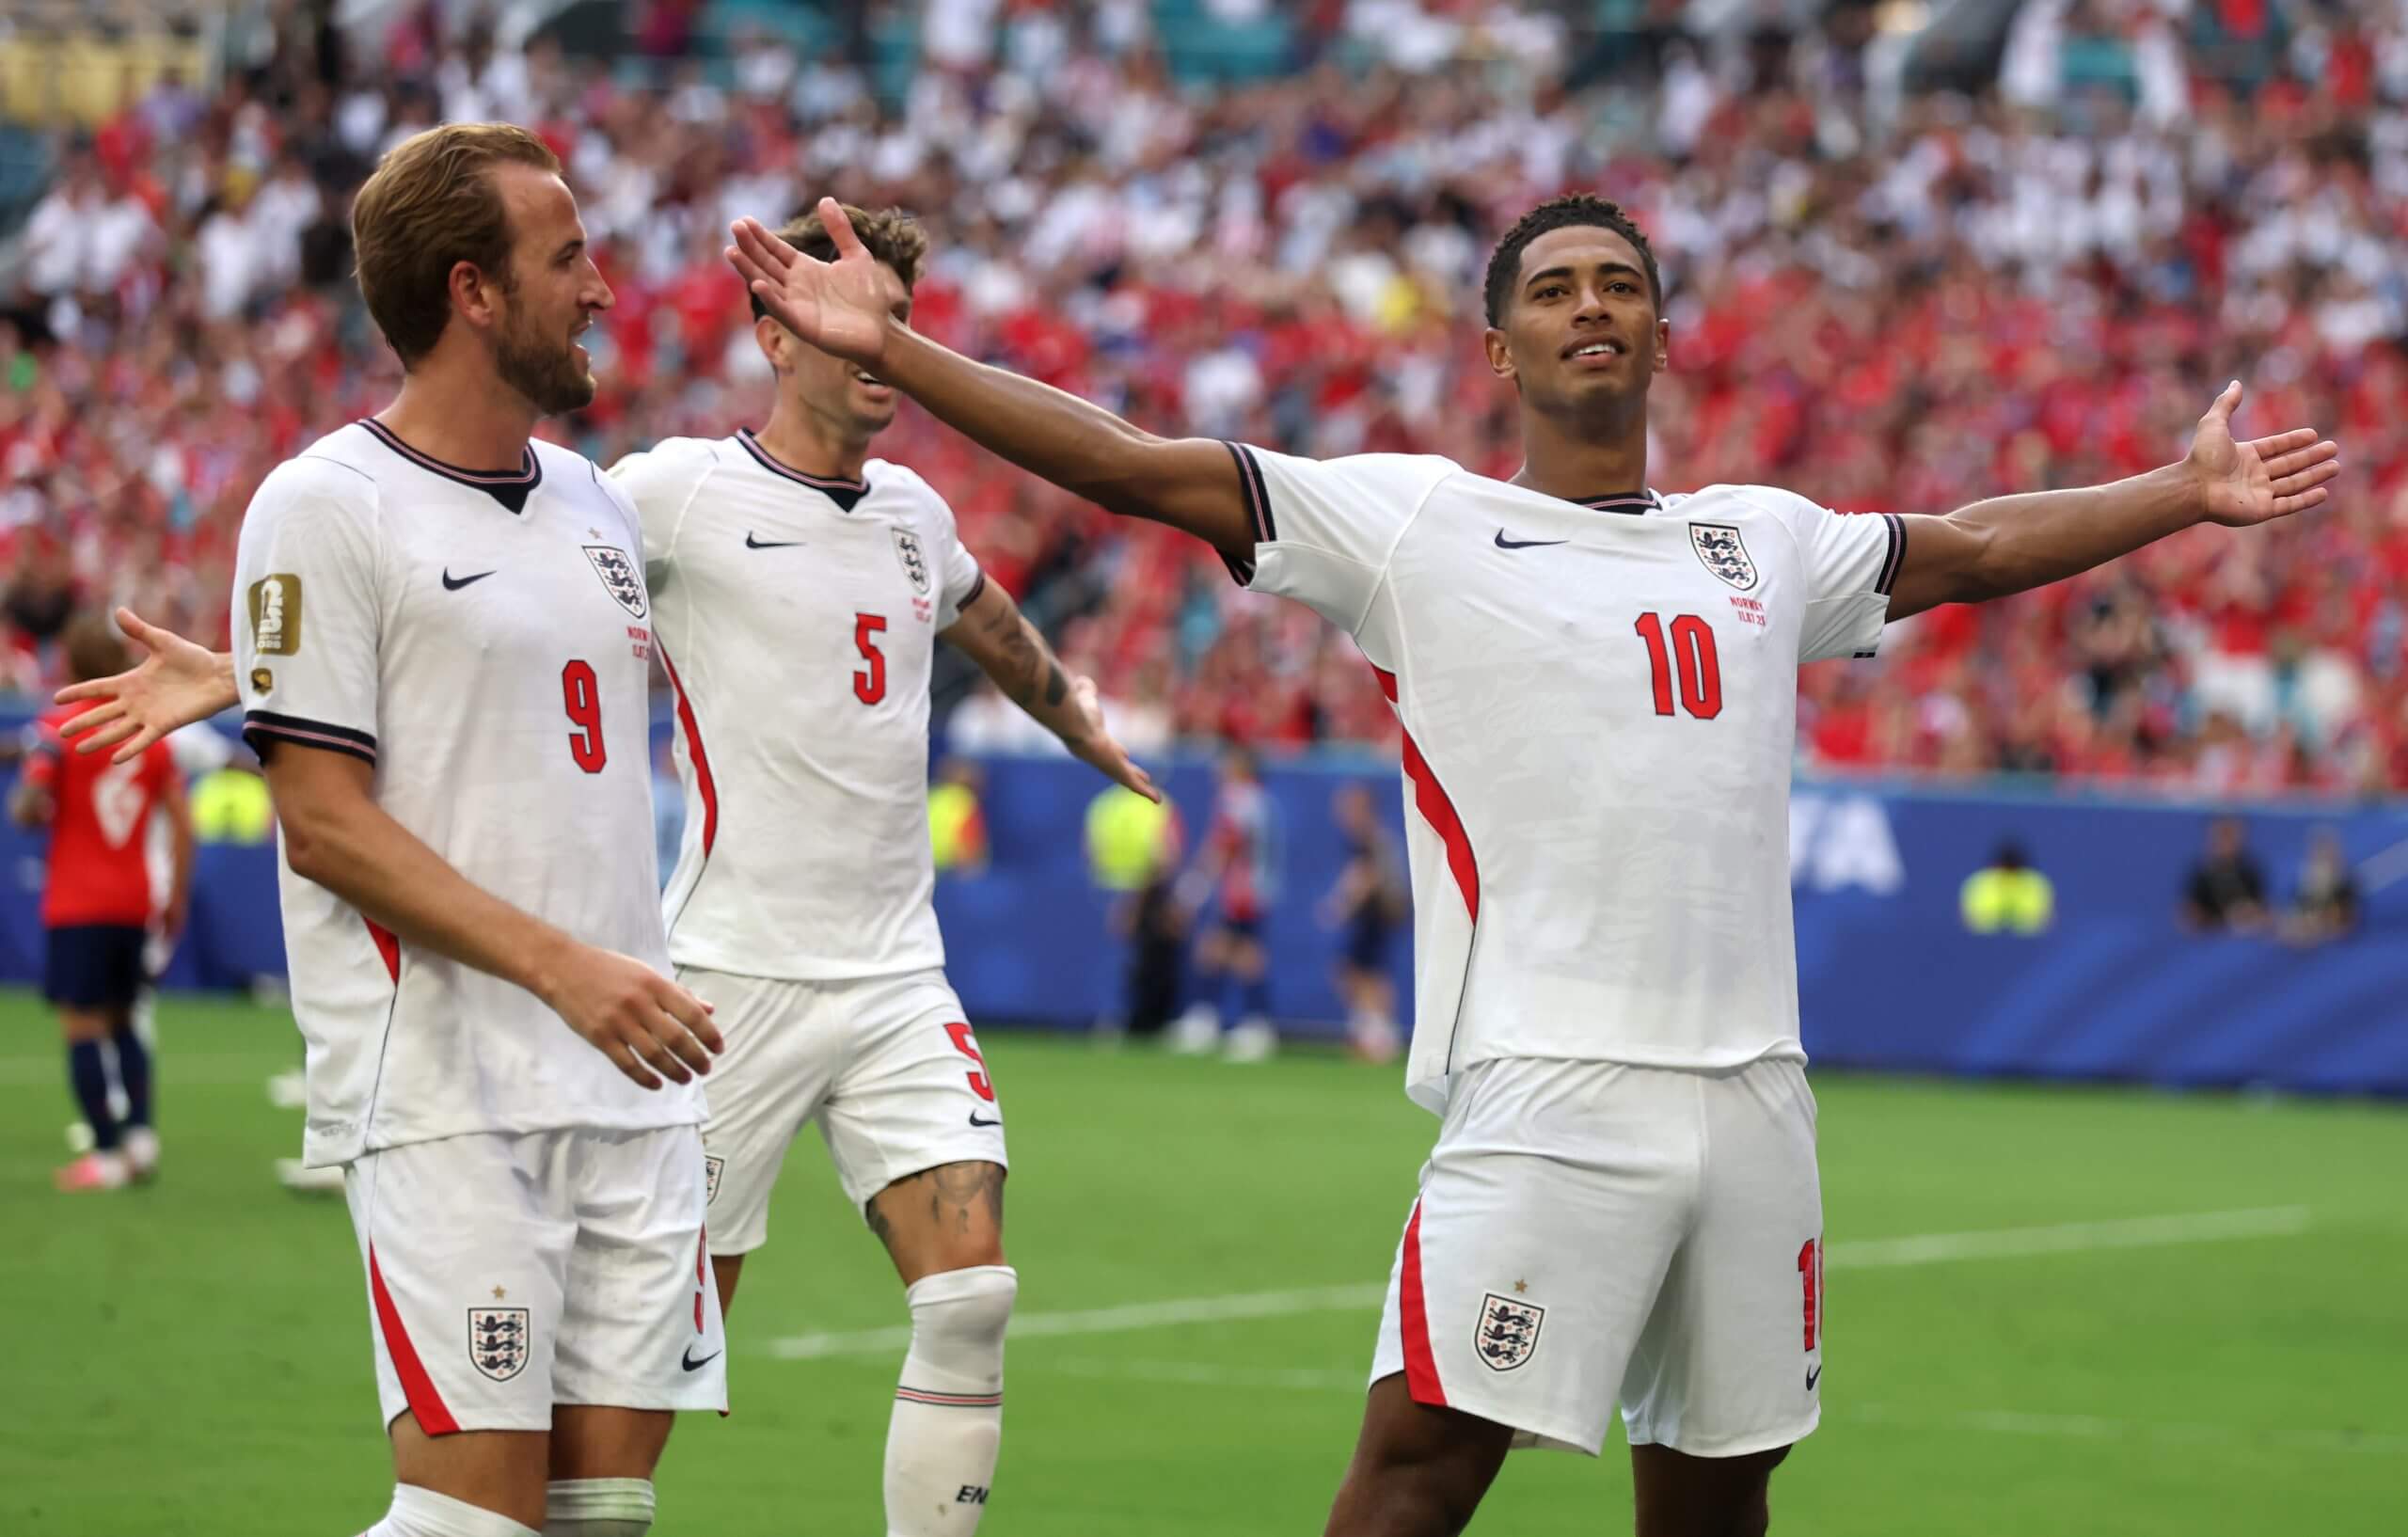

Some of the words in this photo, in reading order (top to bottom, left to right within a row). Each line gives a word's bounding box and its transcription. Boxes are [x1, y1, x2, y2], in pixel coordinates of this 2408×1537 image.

[853, 612, 887, 705] 5
[1634, 611, 1722, 720] 10
[562, 659, 607, 773] 9
[943, 1022, 995, 1102] 5
